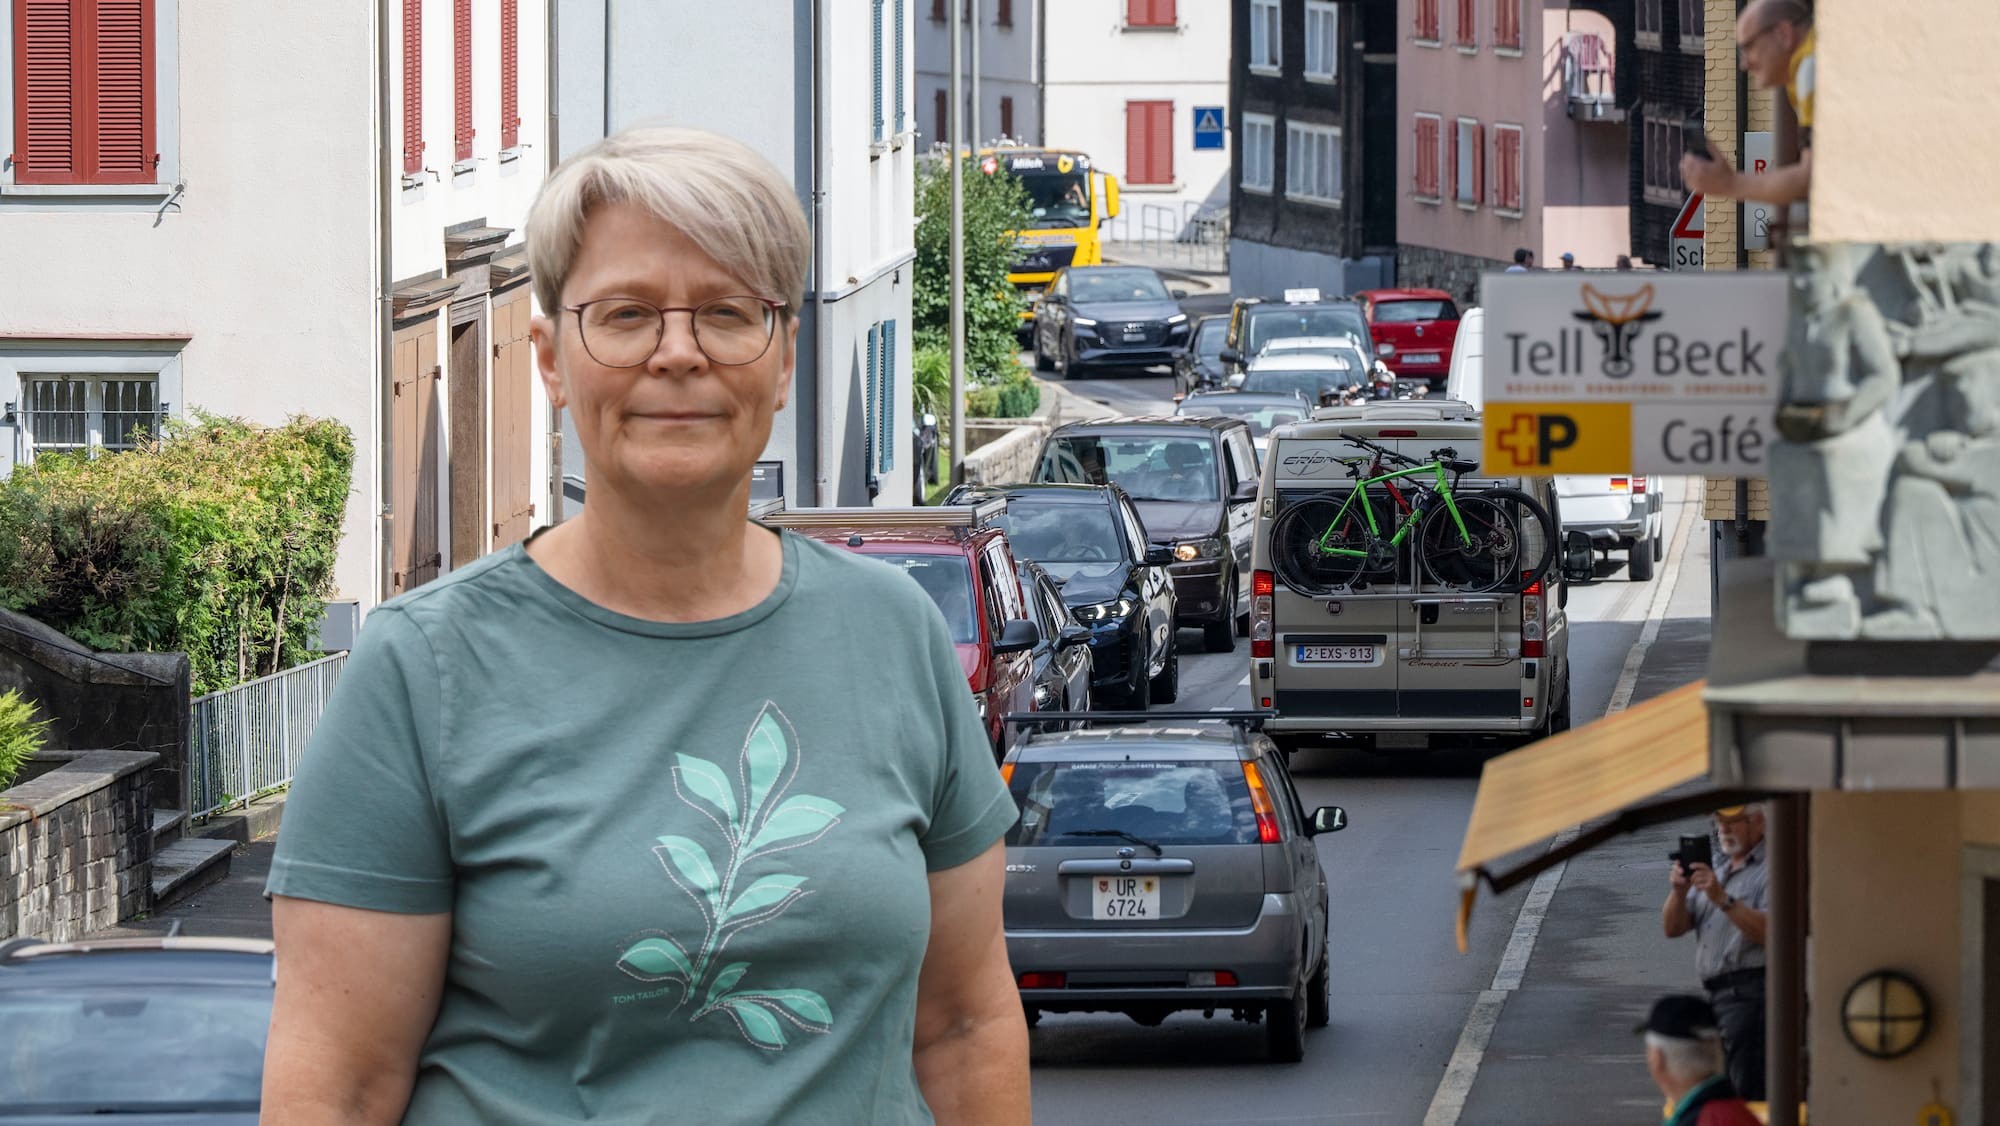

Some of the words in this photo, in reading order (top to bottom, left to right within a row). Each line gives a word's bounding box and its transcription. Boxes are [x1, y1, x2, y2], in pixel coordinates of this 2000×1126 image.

[1505, 328, 1583, 376] Tell
[1653, 328, 1766, 376] Beck
[1661, 415, 1763, 465] Café
[1116, 879, 1136, 897] UR
[1106, 899, 1146, 917] 6724
[612, 994, 635, 1004] TOM
